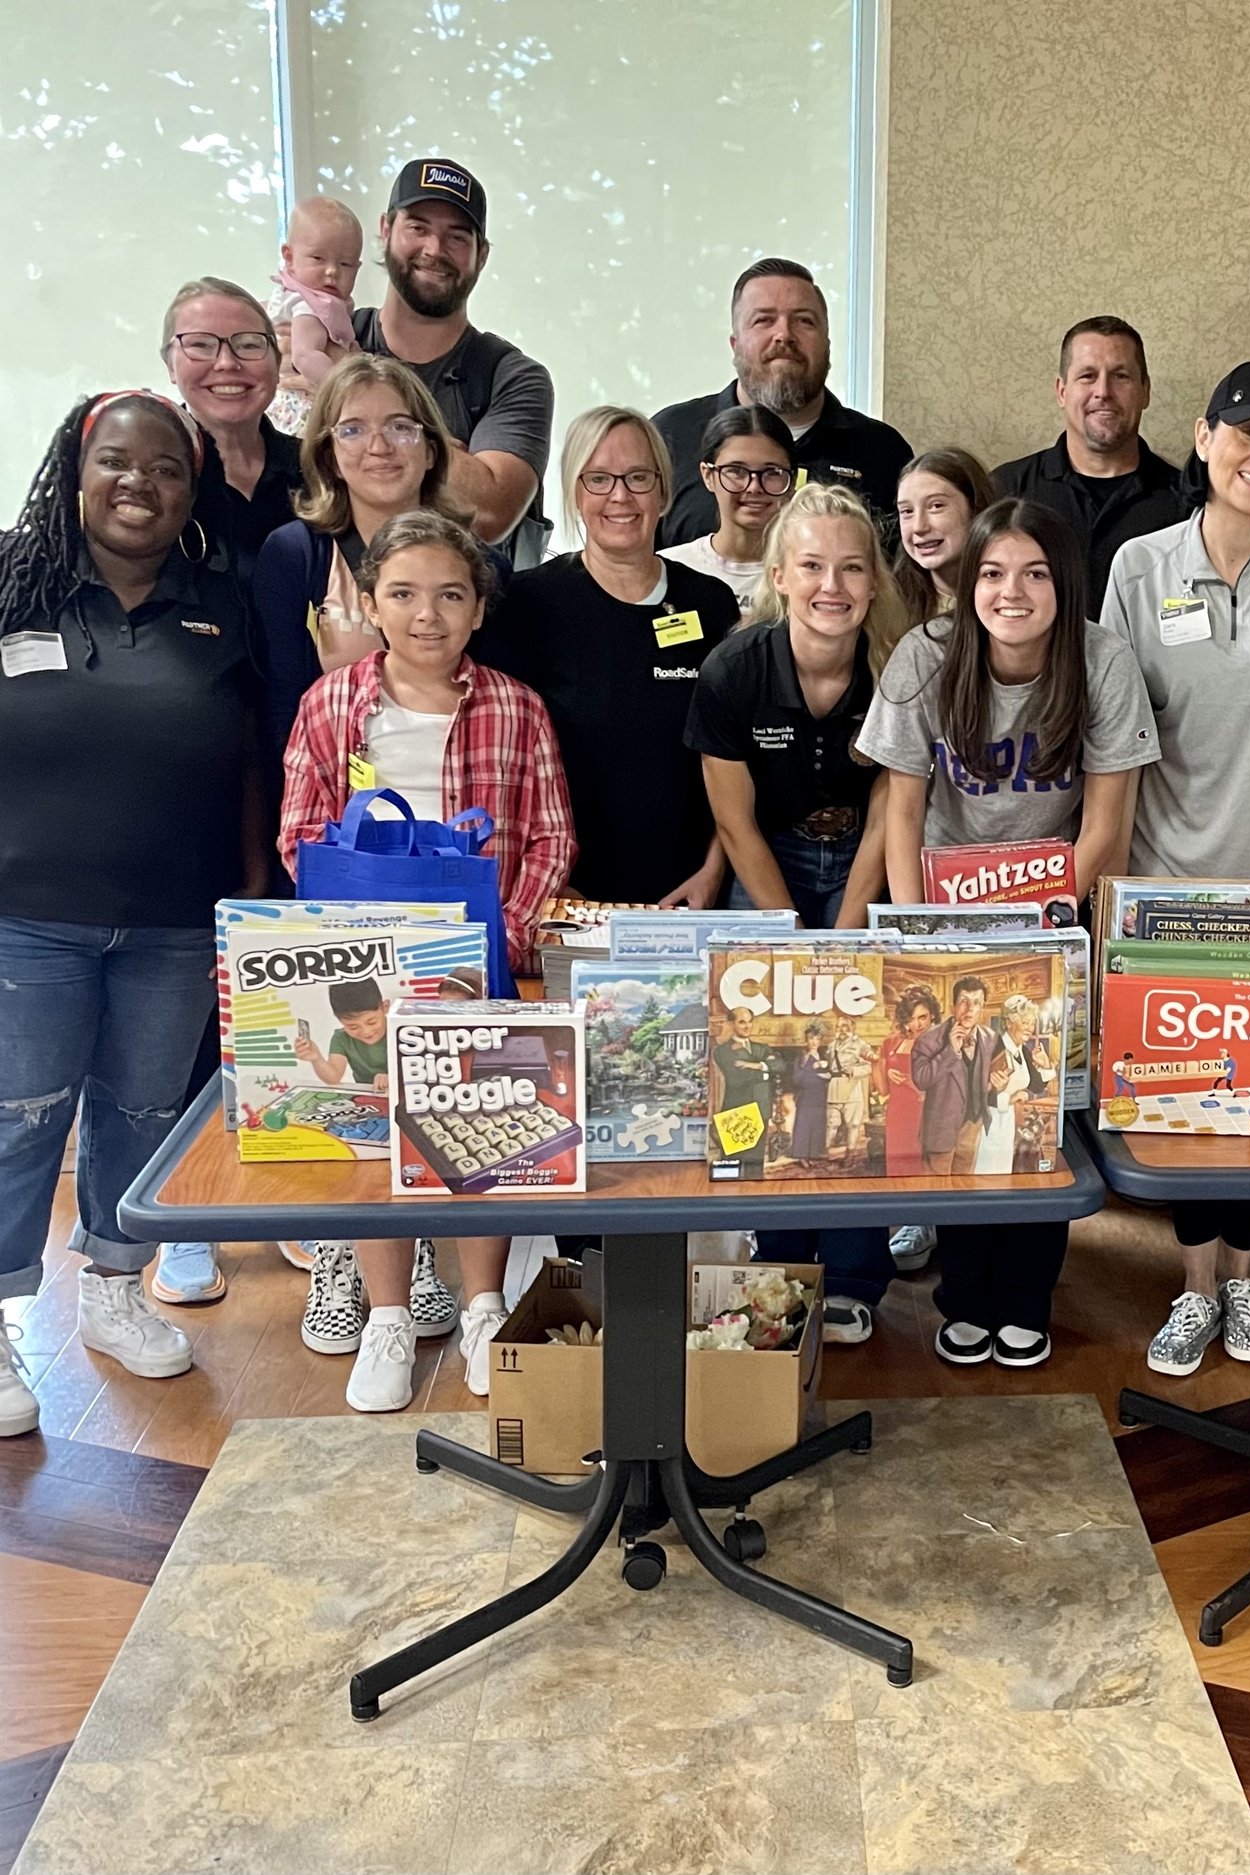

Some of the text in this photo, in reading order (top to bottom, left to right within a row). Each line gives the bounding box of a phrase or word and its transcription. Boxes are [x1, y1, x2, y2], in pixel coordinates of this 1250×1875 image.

[426, 168, 467, 187] Illinois
[939, 854, 1066, 905] Yahtzee
[1156, 920, 1195, 931] CHESS,
[1151, 931, 1201, 941] CHINESE
[240, 938, 392, 989] SORRY!
[719, 959, 877, 1017] Clue
[398, 1025, 509, 1055] Super
[401, 1052, 463, 1085] Big
[1133, 1062, 1222, 1075] GAME ON
[404, 1074, 537, 1115] Boggle
[517, 1158, 535, 1167] The
[490, 1168, 558, 1177] Biggest Boggle
[497, 1176, 554, 1185] Game EVER!
